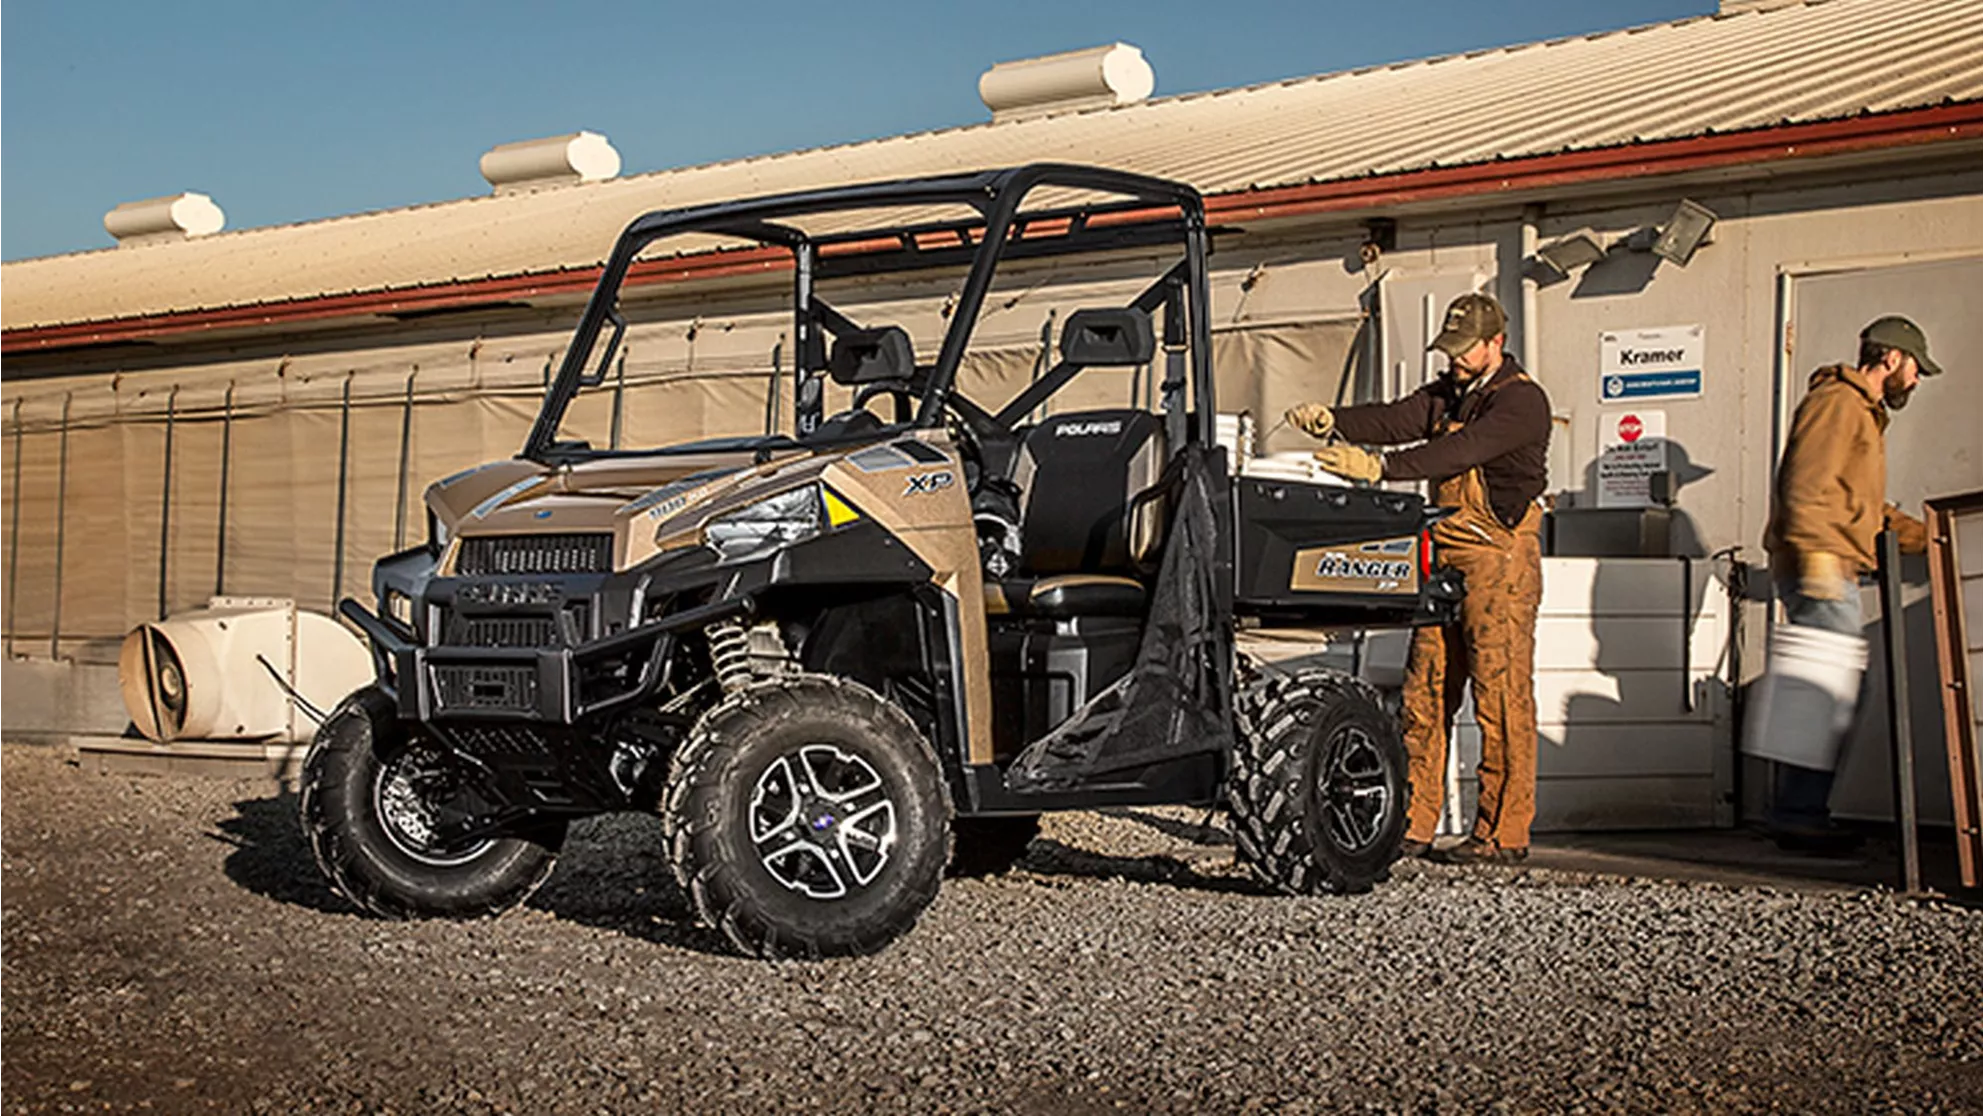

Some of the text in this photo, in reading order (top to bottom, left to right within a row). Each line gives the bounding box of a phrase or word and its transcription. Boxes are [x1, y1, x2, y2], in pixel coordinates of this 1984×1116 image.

[1620, 349, 1684, 365] Kramer
[1054, 420, 1121, 437] POLARIS
[902, 470, 953, 496] XP
[1316, 556, 1411, 578] RANGER
